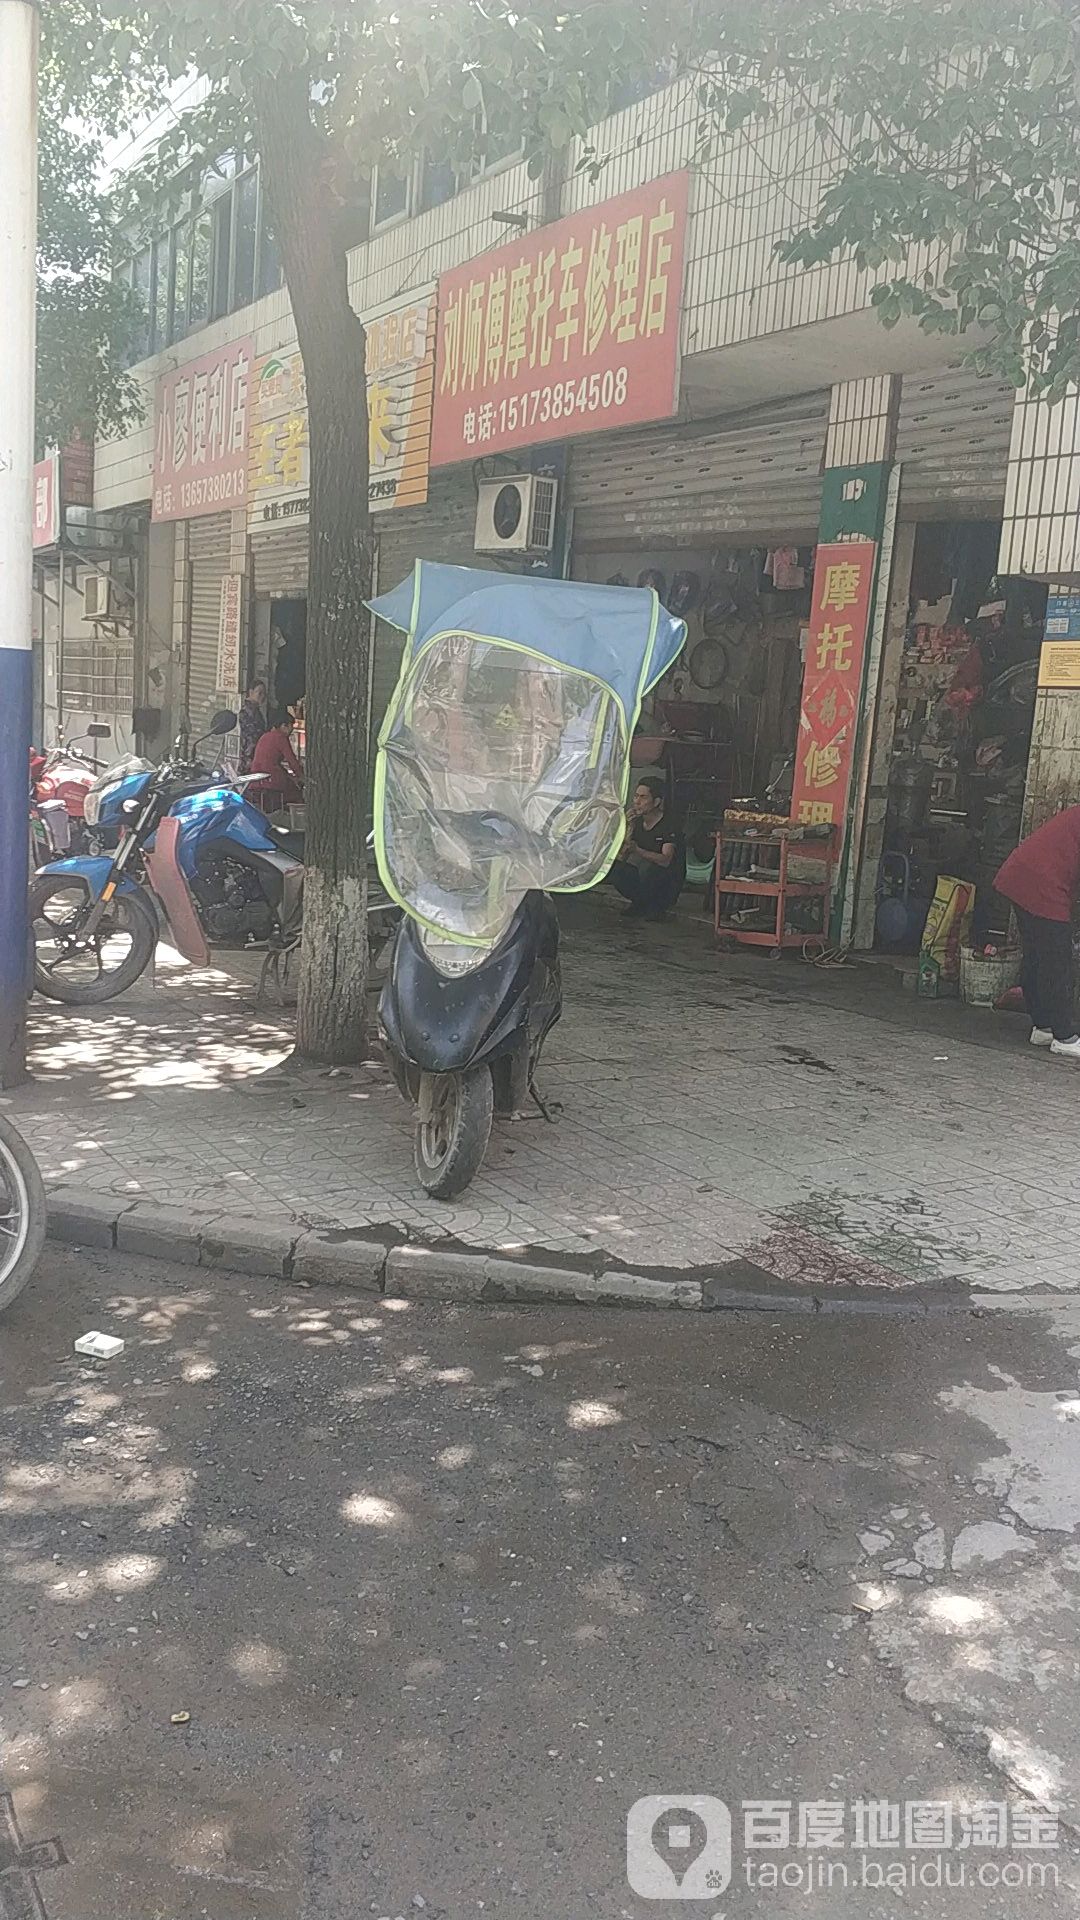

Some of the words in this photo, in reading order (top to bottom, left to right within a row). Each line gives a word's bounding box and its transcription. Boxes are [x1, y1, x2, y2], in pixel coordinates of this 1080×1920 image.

[441, 198, 674, 397] 刘师傅摩托车修理店
[463, 366, 628, 444] 电话:15173854508
